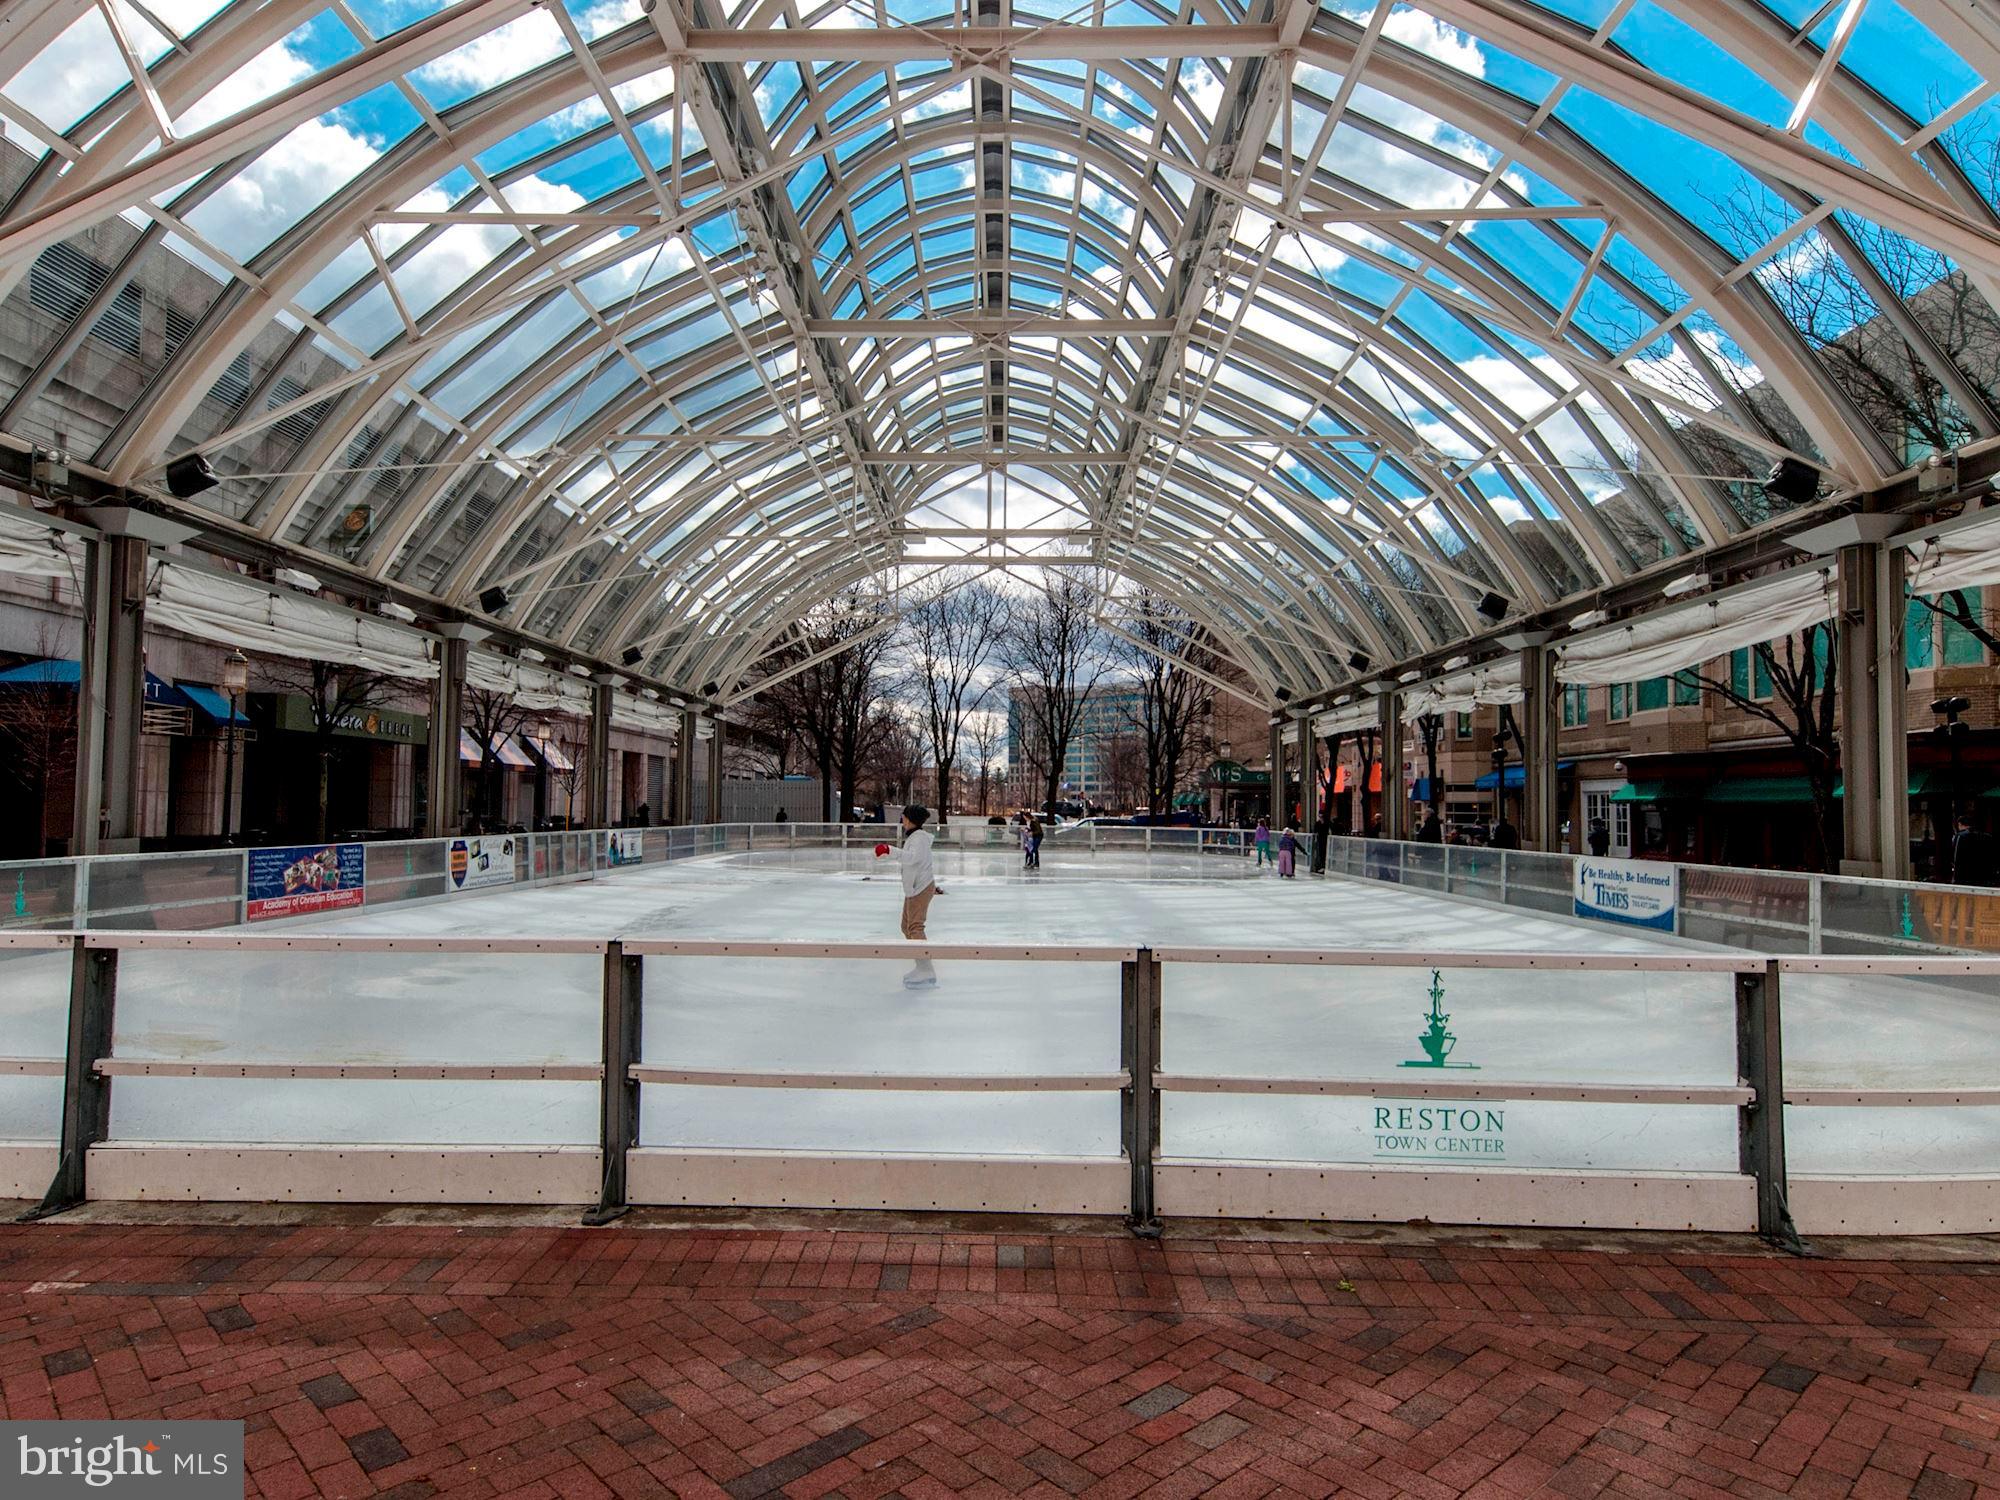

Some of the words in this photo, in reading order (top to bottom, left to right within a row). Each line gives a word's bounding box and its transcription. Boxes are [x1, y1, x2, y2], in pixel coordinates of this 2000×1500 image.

[1588, 868, 1596, 878] Be
[1598, 869, 1624, 883] Healthy,
[1626, 871, 1635, 882] Be
[1636, 874, 1670, 886] Informed
[263, 898, 292, 910] Academy
[292, 897, 300, 906] of
[300, 894, 325, 905] Christian
[326, 891, 354, 902] Education
[1593, 882, 1629, 910] TIMES
[1374, 1107, 1505, 1132] RESTON
[1374, 1135, 1427, 1151] TOWN
[1435, 1136, 1505, 1153] CENTER
